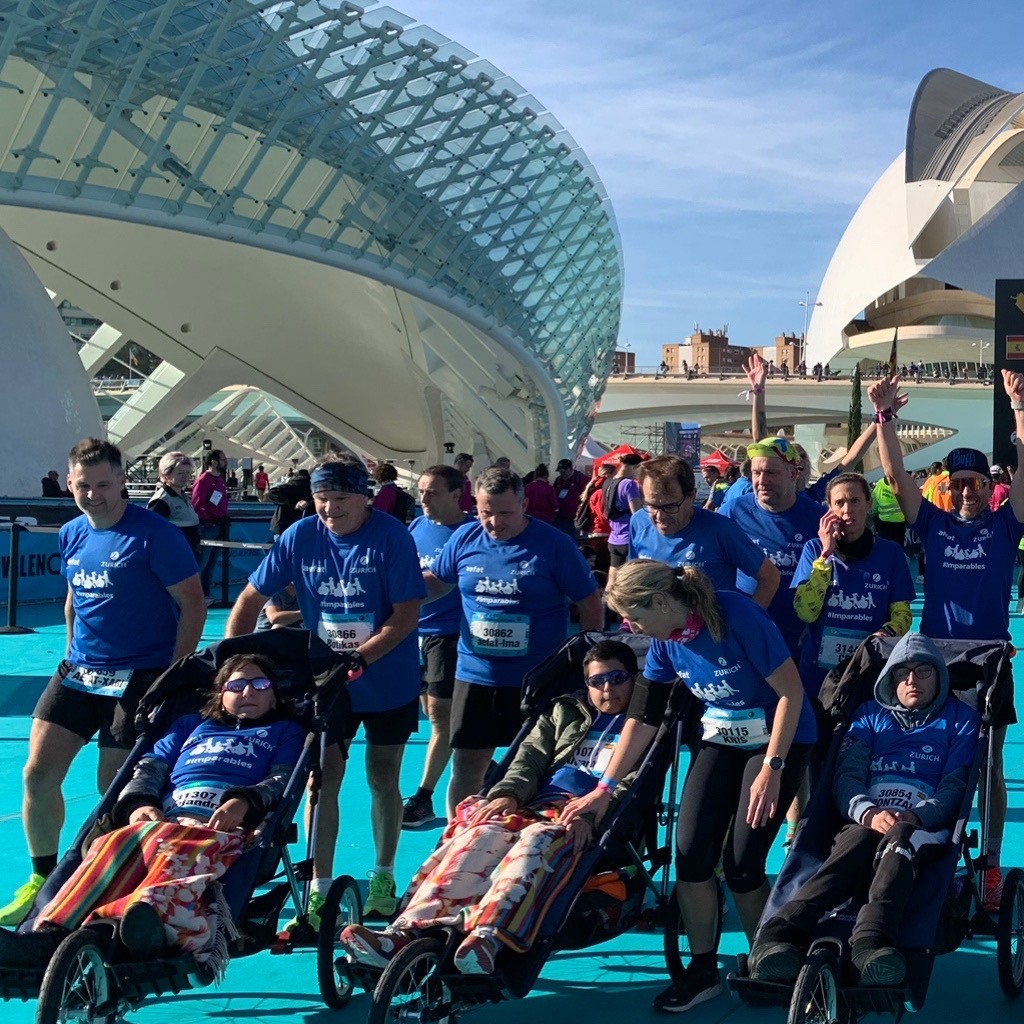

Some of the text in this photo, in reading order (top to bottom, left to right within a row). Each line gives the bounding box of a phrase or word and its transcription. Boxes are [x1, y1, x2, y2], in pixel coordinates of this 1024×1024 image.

[942, 561, 986, 571] #Imparables
[827, 611, 873, 622] #Imparables
[483, 628, 514, 638] 30862
[714, 664, 742, 678] ZURICH
[715, 726, 749, 736] 30115
[722, 735, 749, 744] KRIS
[184, 754, 253, 769] #Imparables
[909, 751, 940, 763] ZURICH
[877, 788, 913, 801] 30854
